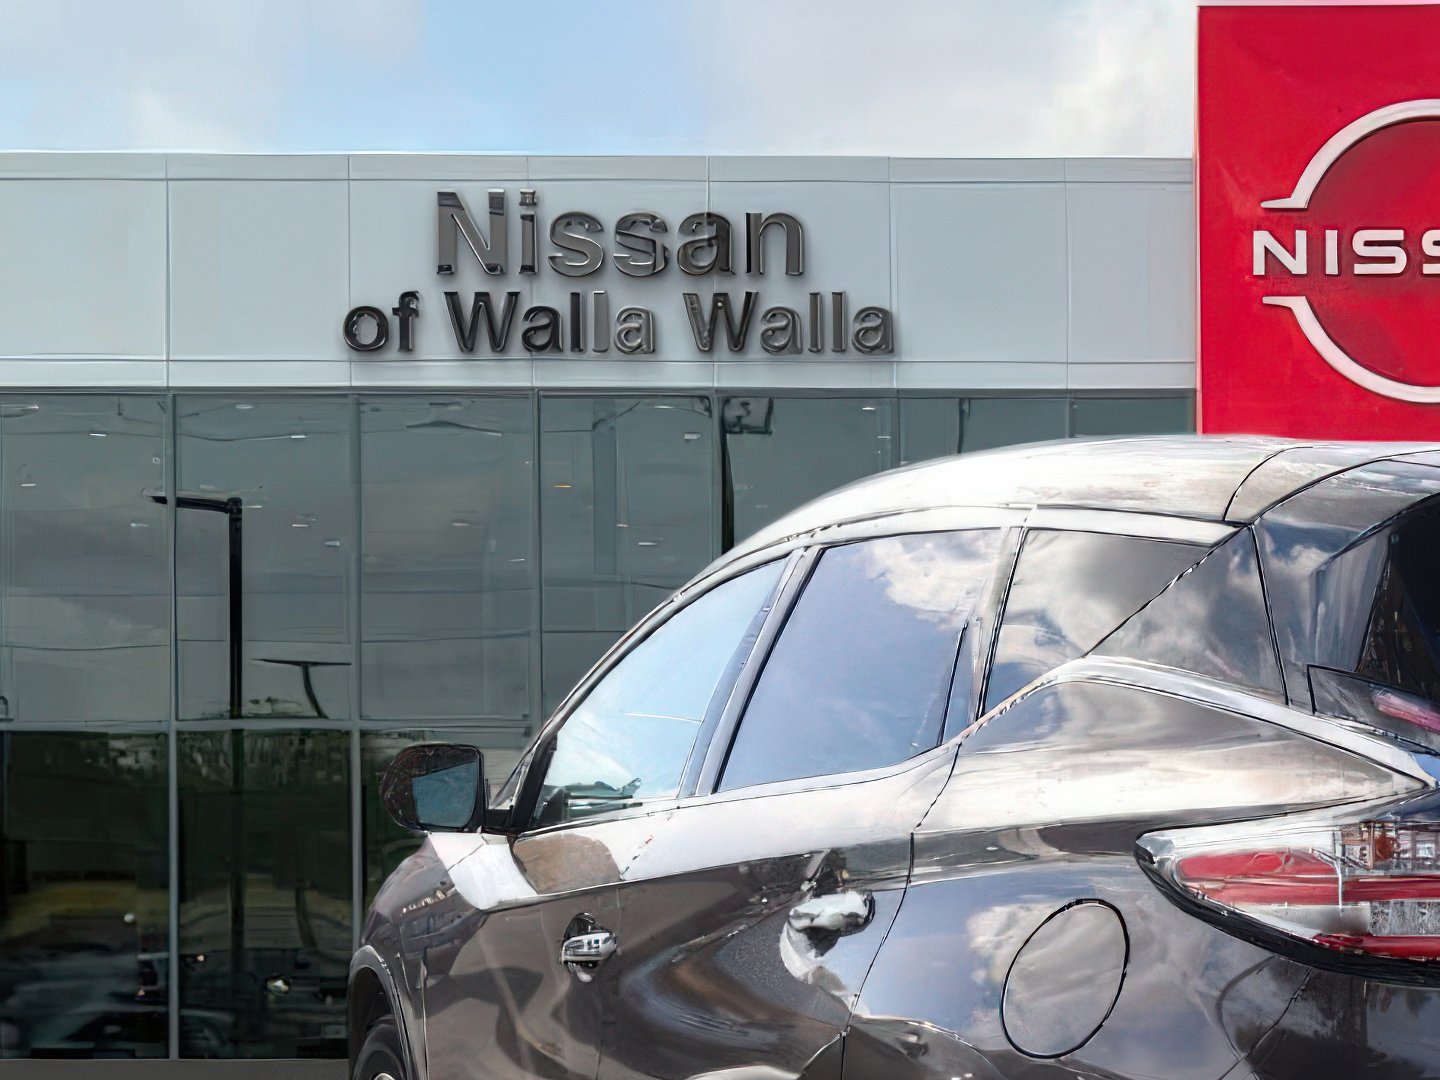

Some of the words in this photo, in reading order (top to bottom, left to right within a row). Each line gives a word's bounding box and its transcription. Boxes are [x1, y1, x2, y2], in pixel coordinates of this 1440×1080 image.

[436, 188, 805, 277] Nissan
[341, 290, 421, 354] of
[443, 290, 657, 354] Walla
[682, 290, 896, 354] Walla
